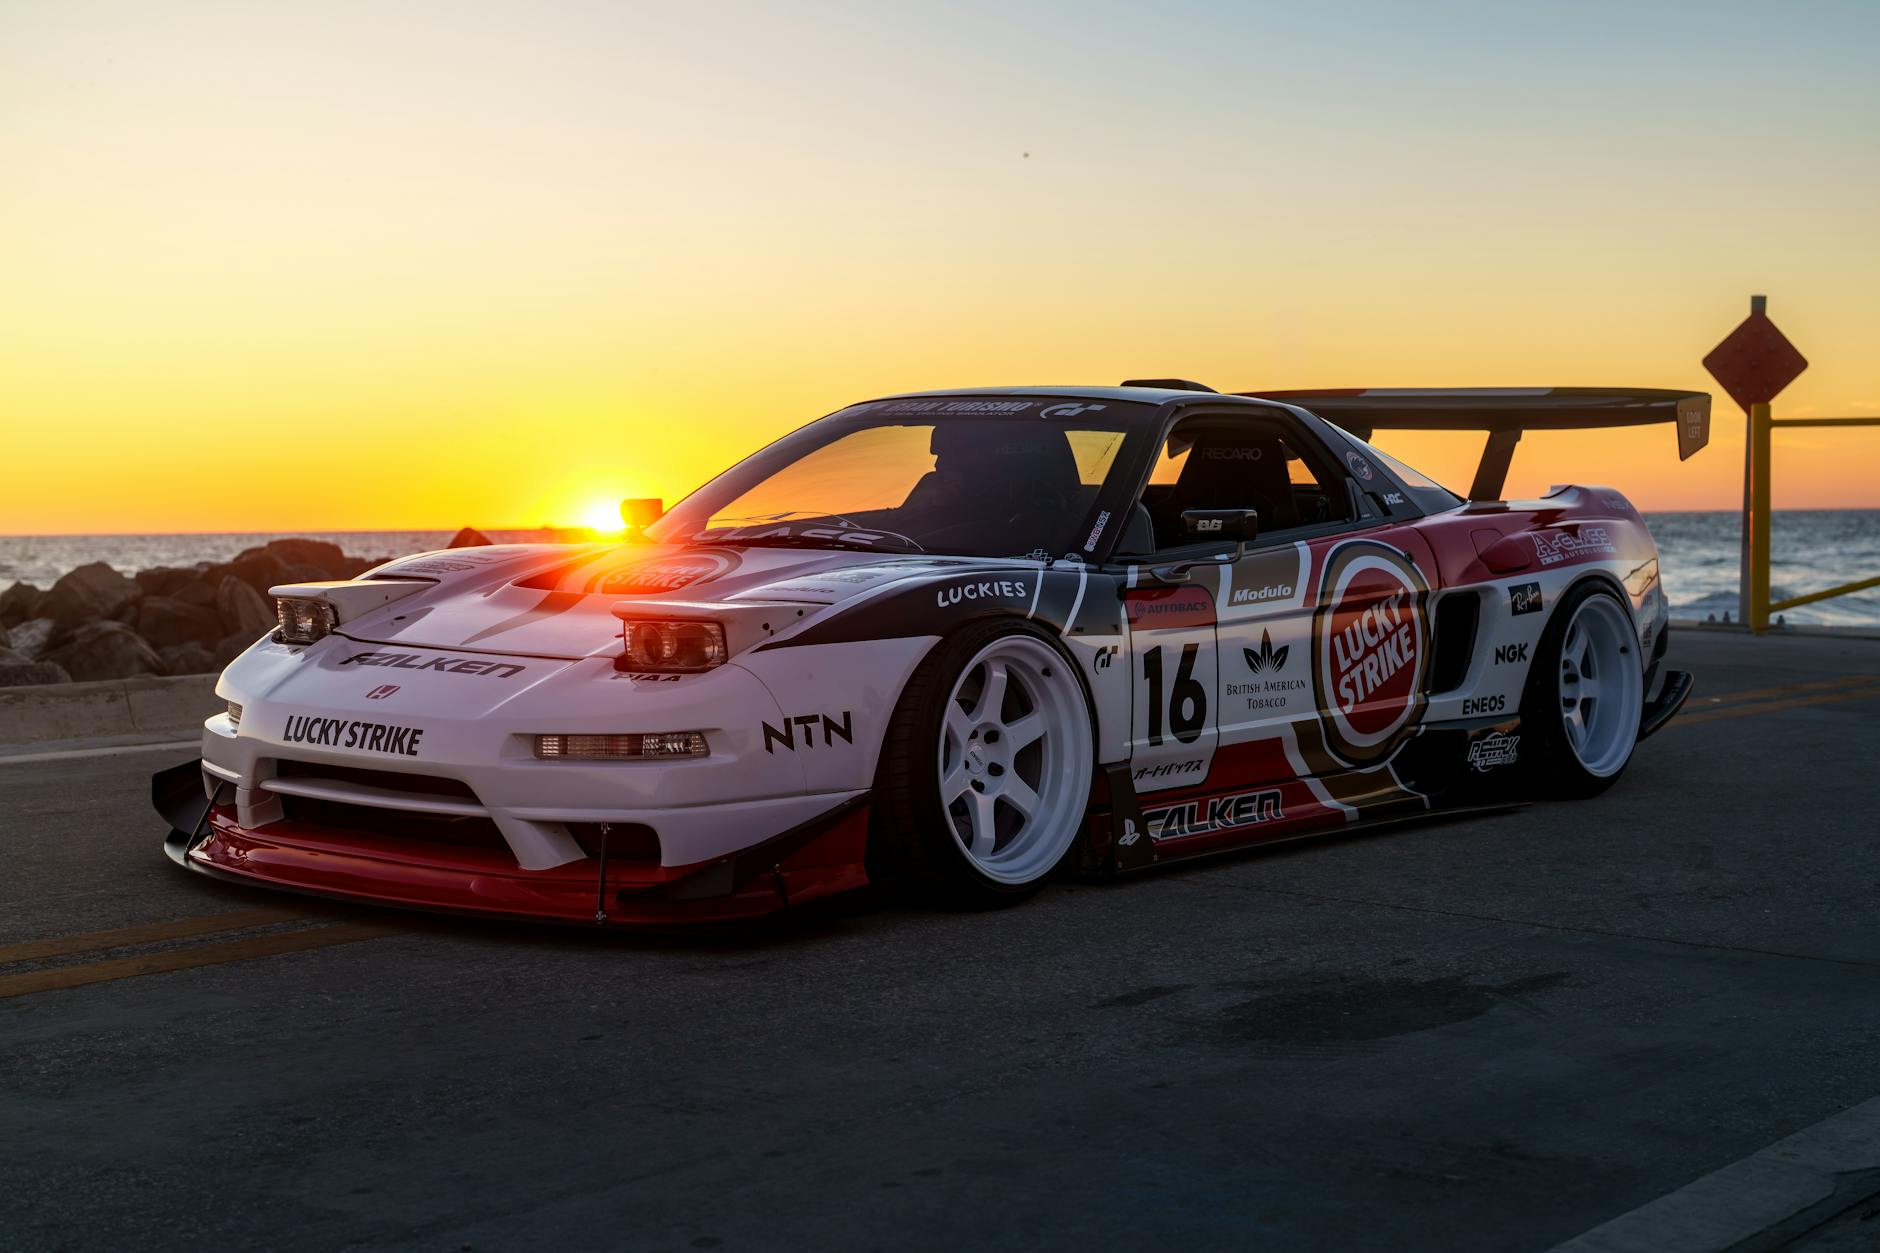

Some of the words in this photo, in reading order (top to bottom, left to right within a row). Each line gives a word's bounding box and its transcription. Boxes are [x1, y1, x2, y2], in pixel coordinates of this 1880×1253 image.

[937, 401, 1034, 411] TURISMO
[1201, 447, 1263, 461] RECARO
[1383, 492, 1404, 505] HRC
[937, 581, 1027, 608] LUCKIES
[1233, 585, 1292, 602] Modulo
[1148, 602, 1208, 614] AUTOBACS
[1334, 587, 1404, 673] LUCKY
[1495, 643, 1528, 665] NGK
[1339, 623, 1415, 714] STRIKE
[1144, 643, 1207, 747] 16
[1226, 683, 1260, 696] BRITISH
[1264, 680, 1306, 692] AMERICAN
[1247, 697, 1286, 710] TOBACCO
[1462, 694, 1505, 715] ENEOS
[284, 714, 348, 747] LUCKY
[344, 721, 424, 756] STRIKE
[762, 711, 853, 755] NTN
[1134, 760, 1203, 780] オートバックス
[1142, 788, 1286, 842] FALKEN
